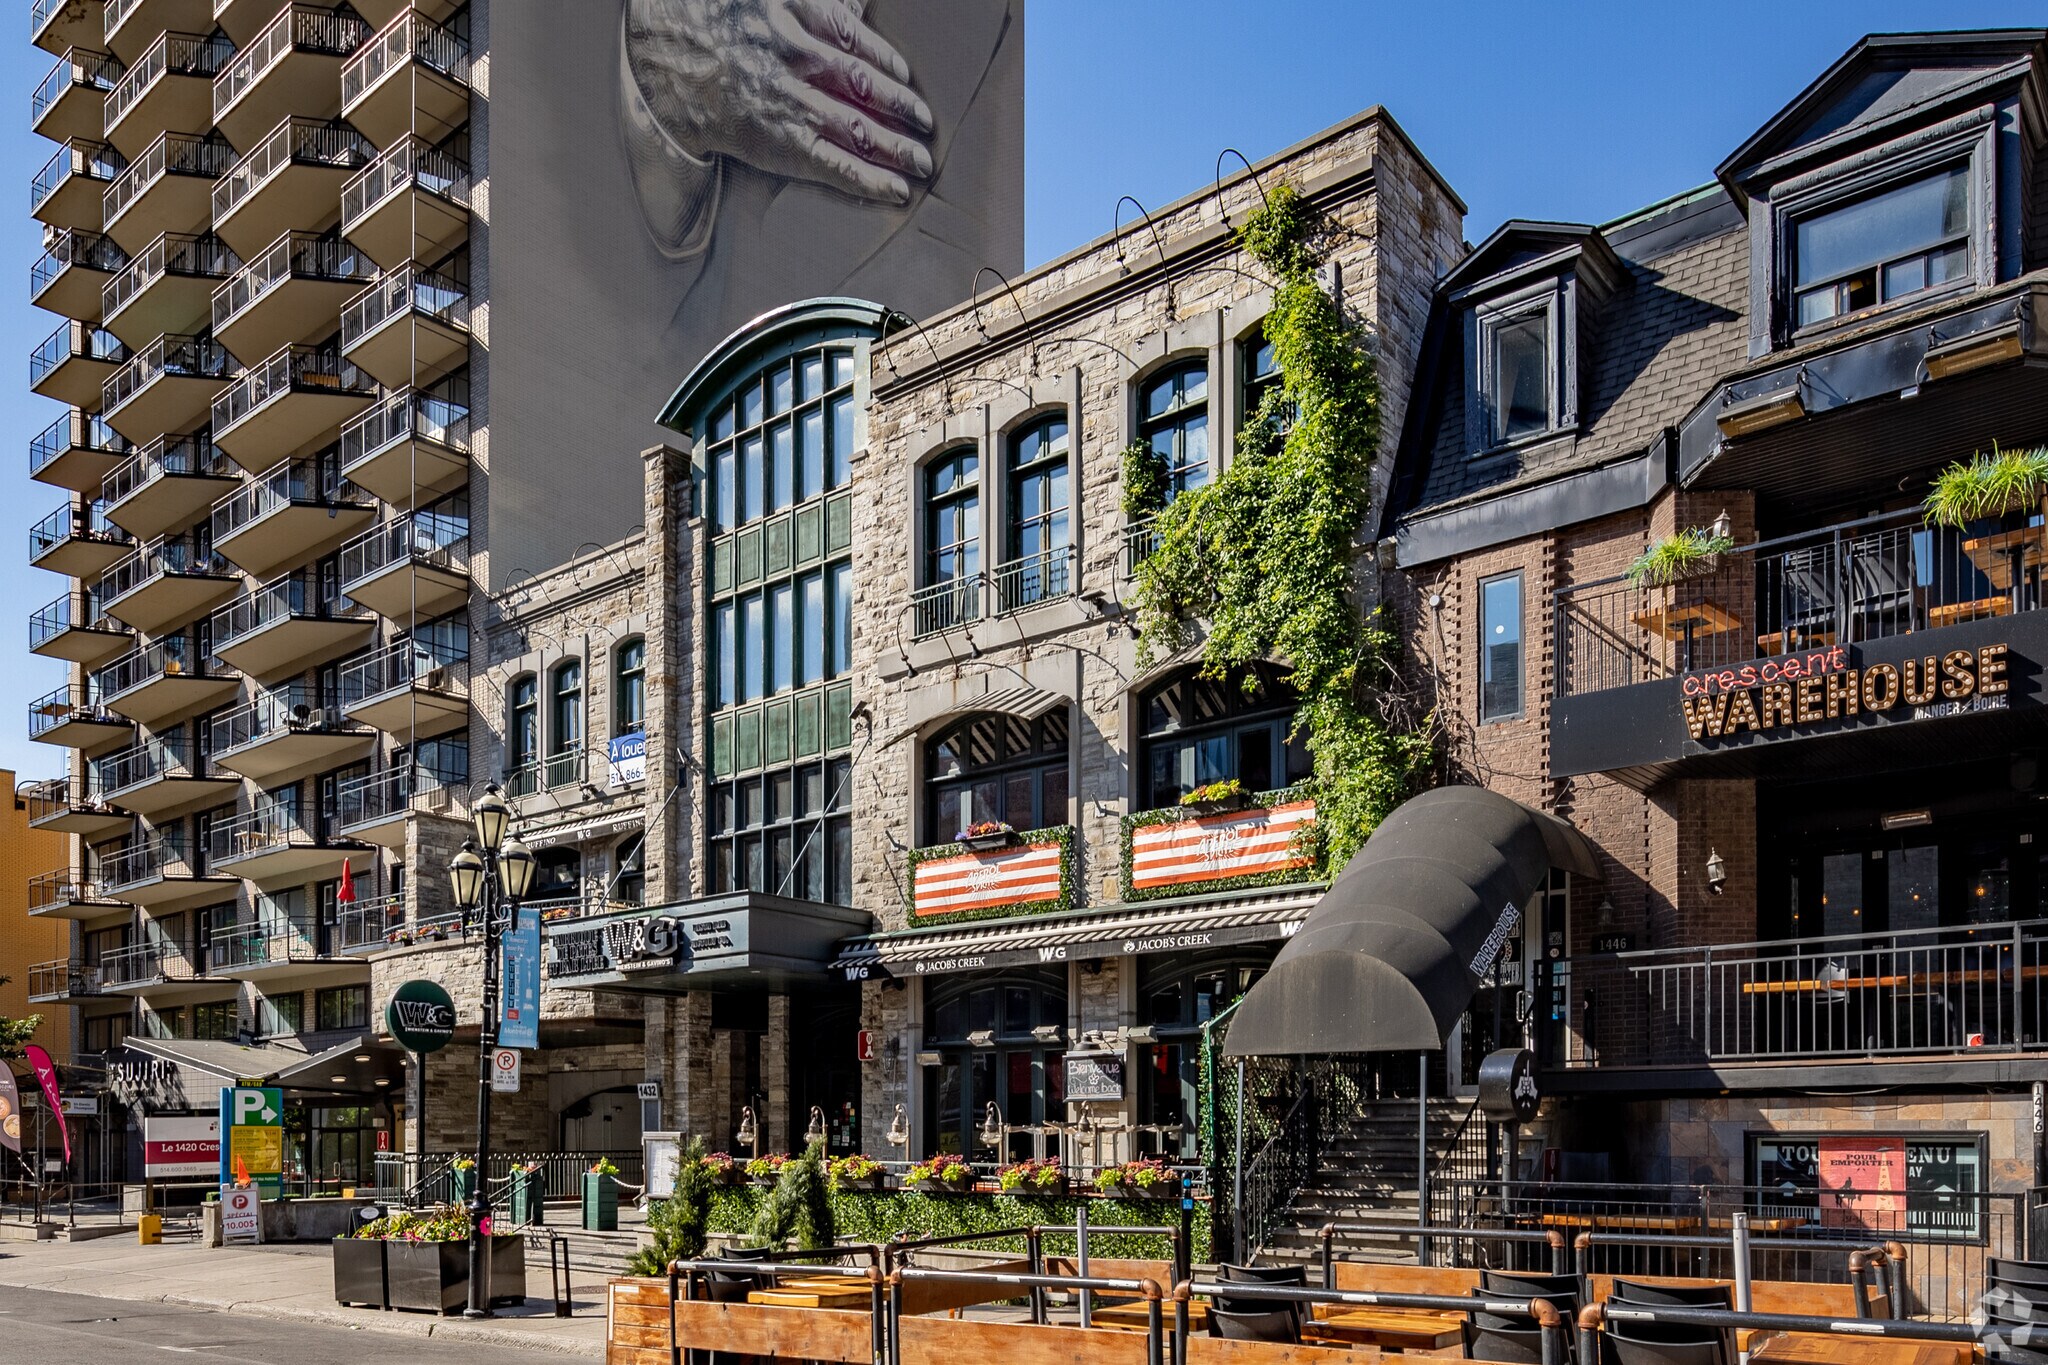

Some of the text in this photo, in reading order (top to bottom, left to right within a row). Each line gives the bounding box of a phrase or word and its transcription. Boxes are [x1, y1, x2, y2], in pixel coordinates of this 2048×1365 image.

[1682, 645, 1845, 696] crescent
[1681, 643, 2009, 739] WAREHOUSE
[1914, 702, 1960, 720] MANGER
[611, 741, 619, 761] À
[526, 837, 556, 849] RUFFINO
[1196, 827, 1241, 856] APEROL
[966, 865, 1001, 888] APEROL
[603, 915, 680, 961] W&G
[1470, 902, 1520, 977] WAREHOUSE
[1600, 937, 1627, 951] 1446
[926, 959, 956, 973] JACOB'S
[958, 957, 985, 968] CREEK
[1136, 937, 1175, 951] JACOB'S
[1177, 934, 1212, 946] CREEK
[395, 1000, 452, 1027] W&G
[1068, 1060, 1120, 1075] Bienvenue
[639, 1085, 656, 1096] 1432
[1101, 1082, 1121, 1092] back
[235, 1090, 265, 1124] P
[2035, 1085, 2043, 1131] 1446
[162, 1143, 220, 1152] Le 1420 Cres
[1782, 1146, 1951, 1164] TOU ENU
[1908, 1166, 1923, 1177] AY
[226, 1220, 254, 1229] 10.00$
